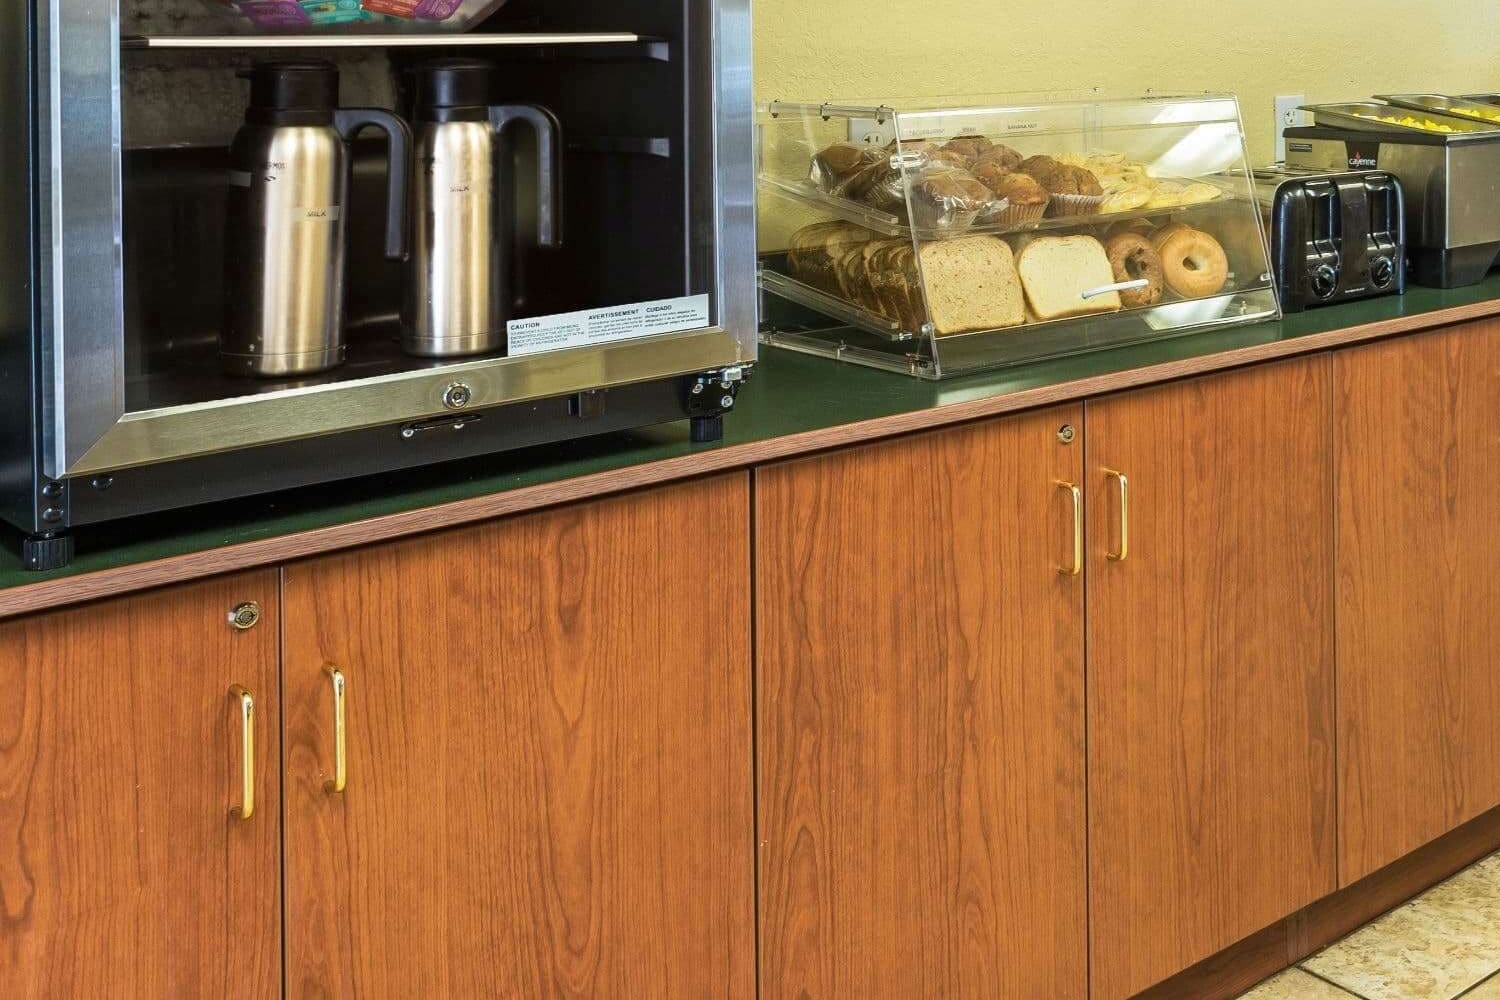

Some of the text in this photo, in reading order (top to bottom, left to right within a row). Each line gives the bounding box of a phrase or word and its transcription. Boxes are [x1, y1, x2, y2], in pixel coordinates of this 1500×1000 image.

[1349, 158, 1377, 167] cayenne
[646, 305, 672, 313] CUIDADO
[588, 308, 639, 320] AVERTISSEMENT
[511, 322, 540, 330] CAUTION
